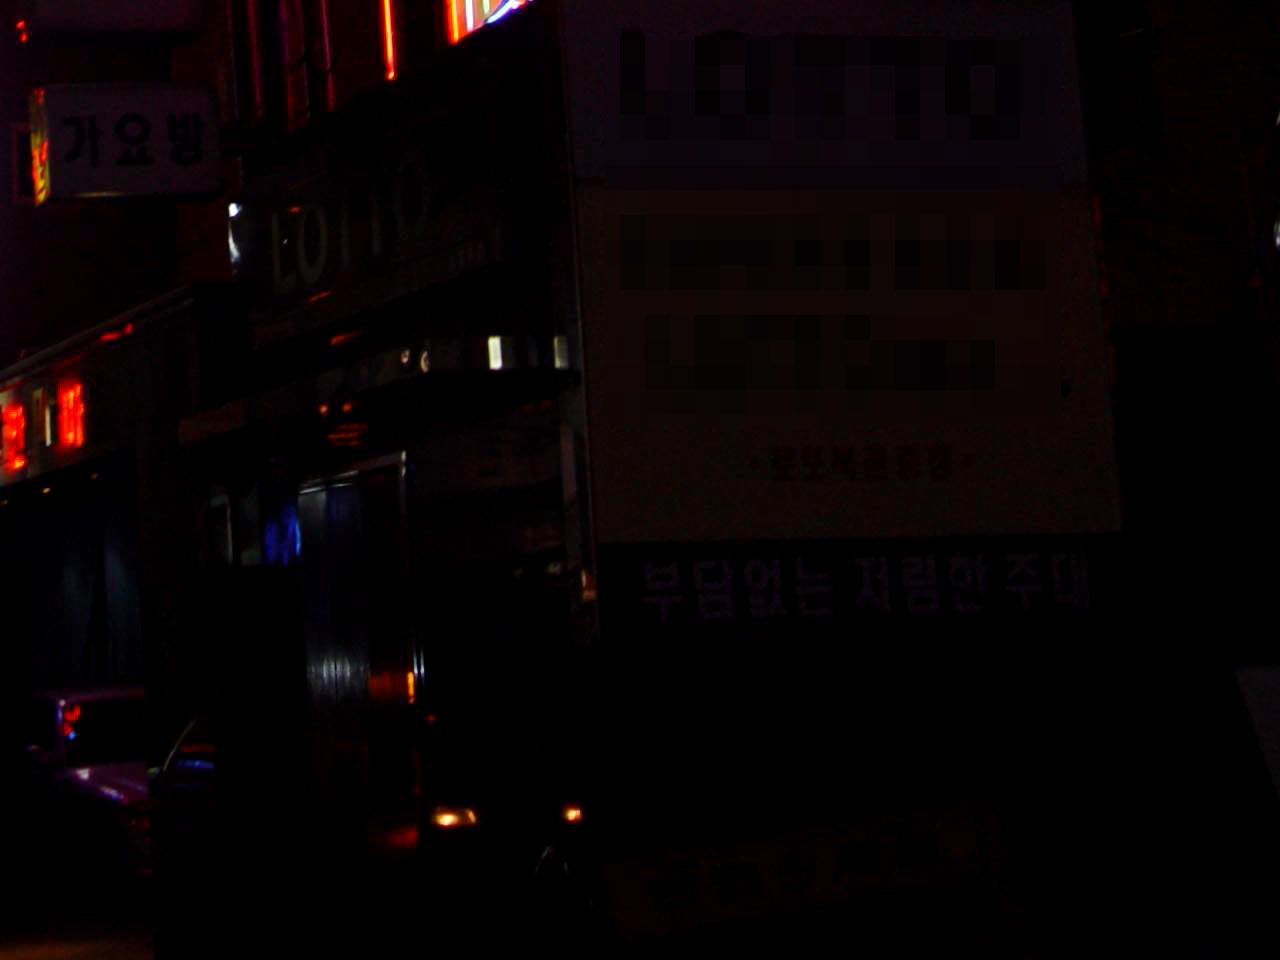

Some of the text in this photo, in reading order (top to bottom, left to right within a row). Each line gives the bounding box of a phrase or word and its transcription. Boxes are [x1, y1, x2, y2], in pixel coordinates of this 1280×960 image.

[61, 112, 207, 167] 가요방
[642, 557, 834, 622] 부담없는
[1004, 549, 1090, 610] 주대
